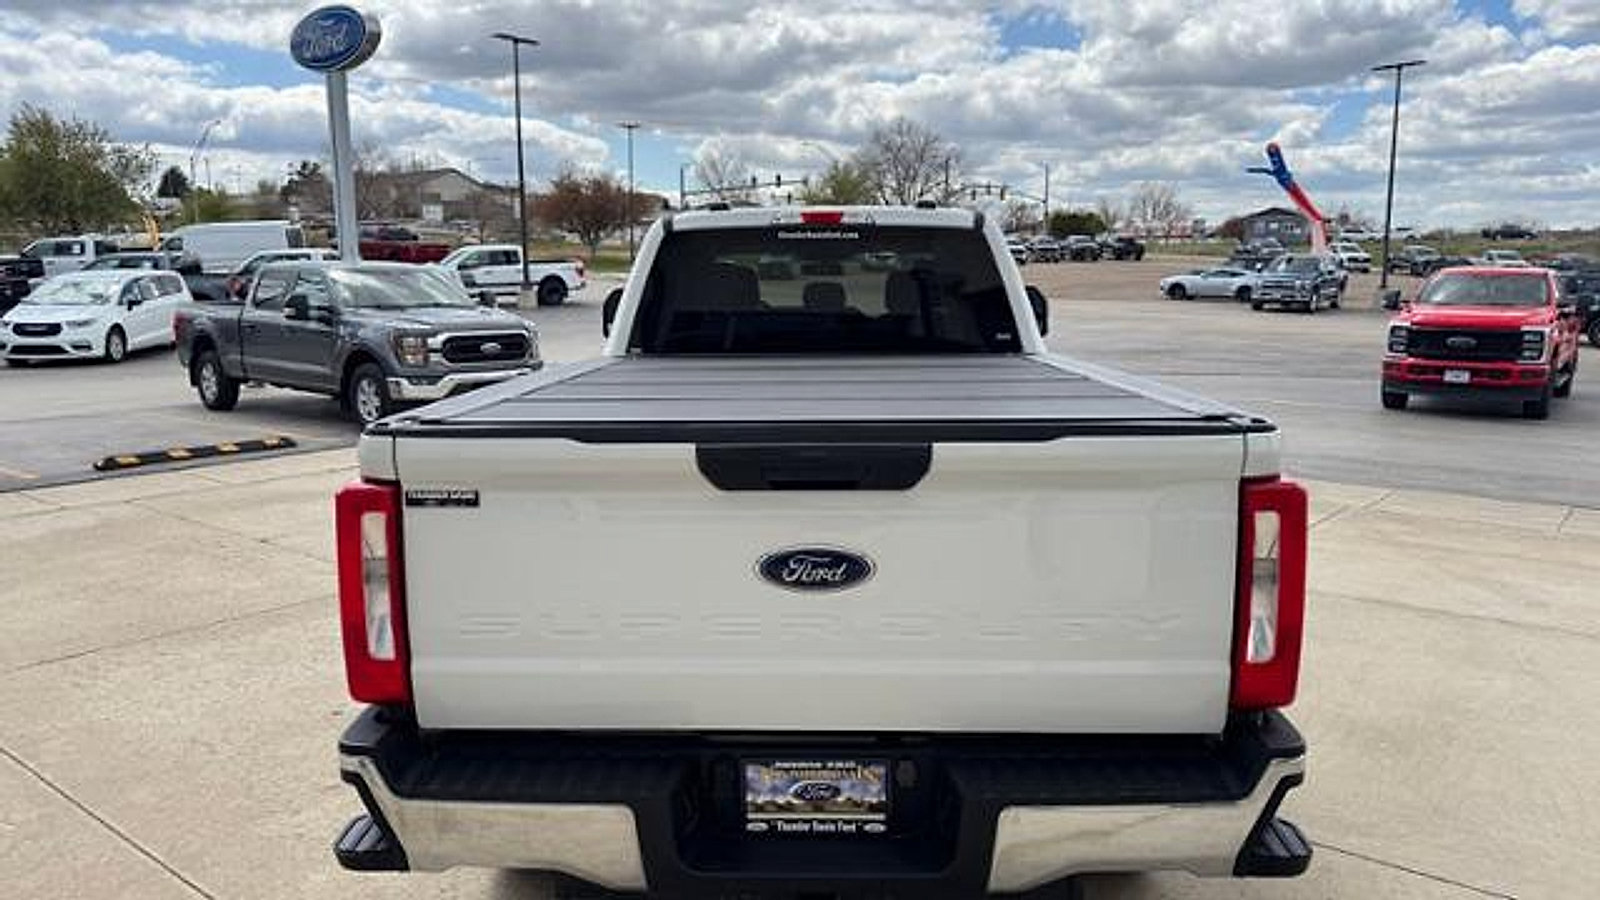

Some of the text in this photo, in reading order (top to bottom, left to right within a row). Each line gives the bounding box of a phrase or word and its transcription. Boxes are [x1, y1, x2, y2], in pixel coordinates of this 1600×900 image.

[303, 19, 349, 58] Ford
[782, 555, 847, 581] Ford
[458, 611, 1183, 642] SUPER DUTY
